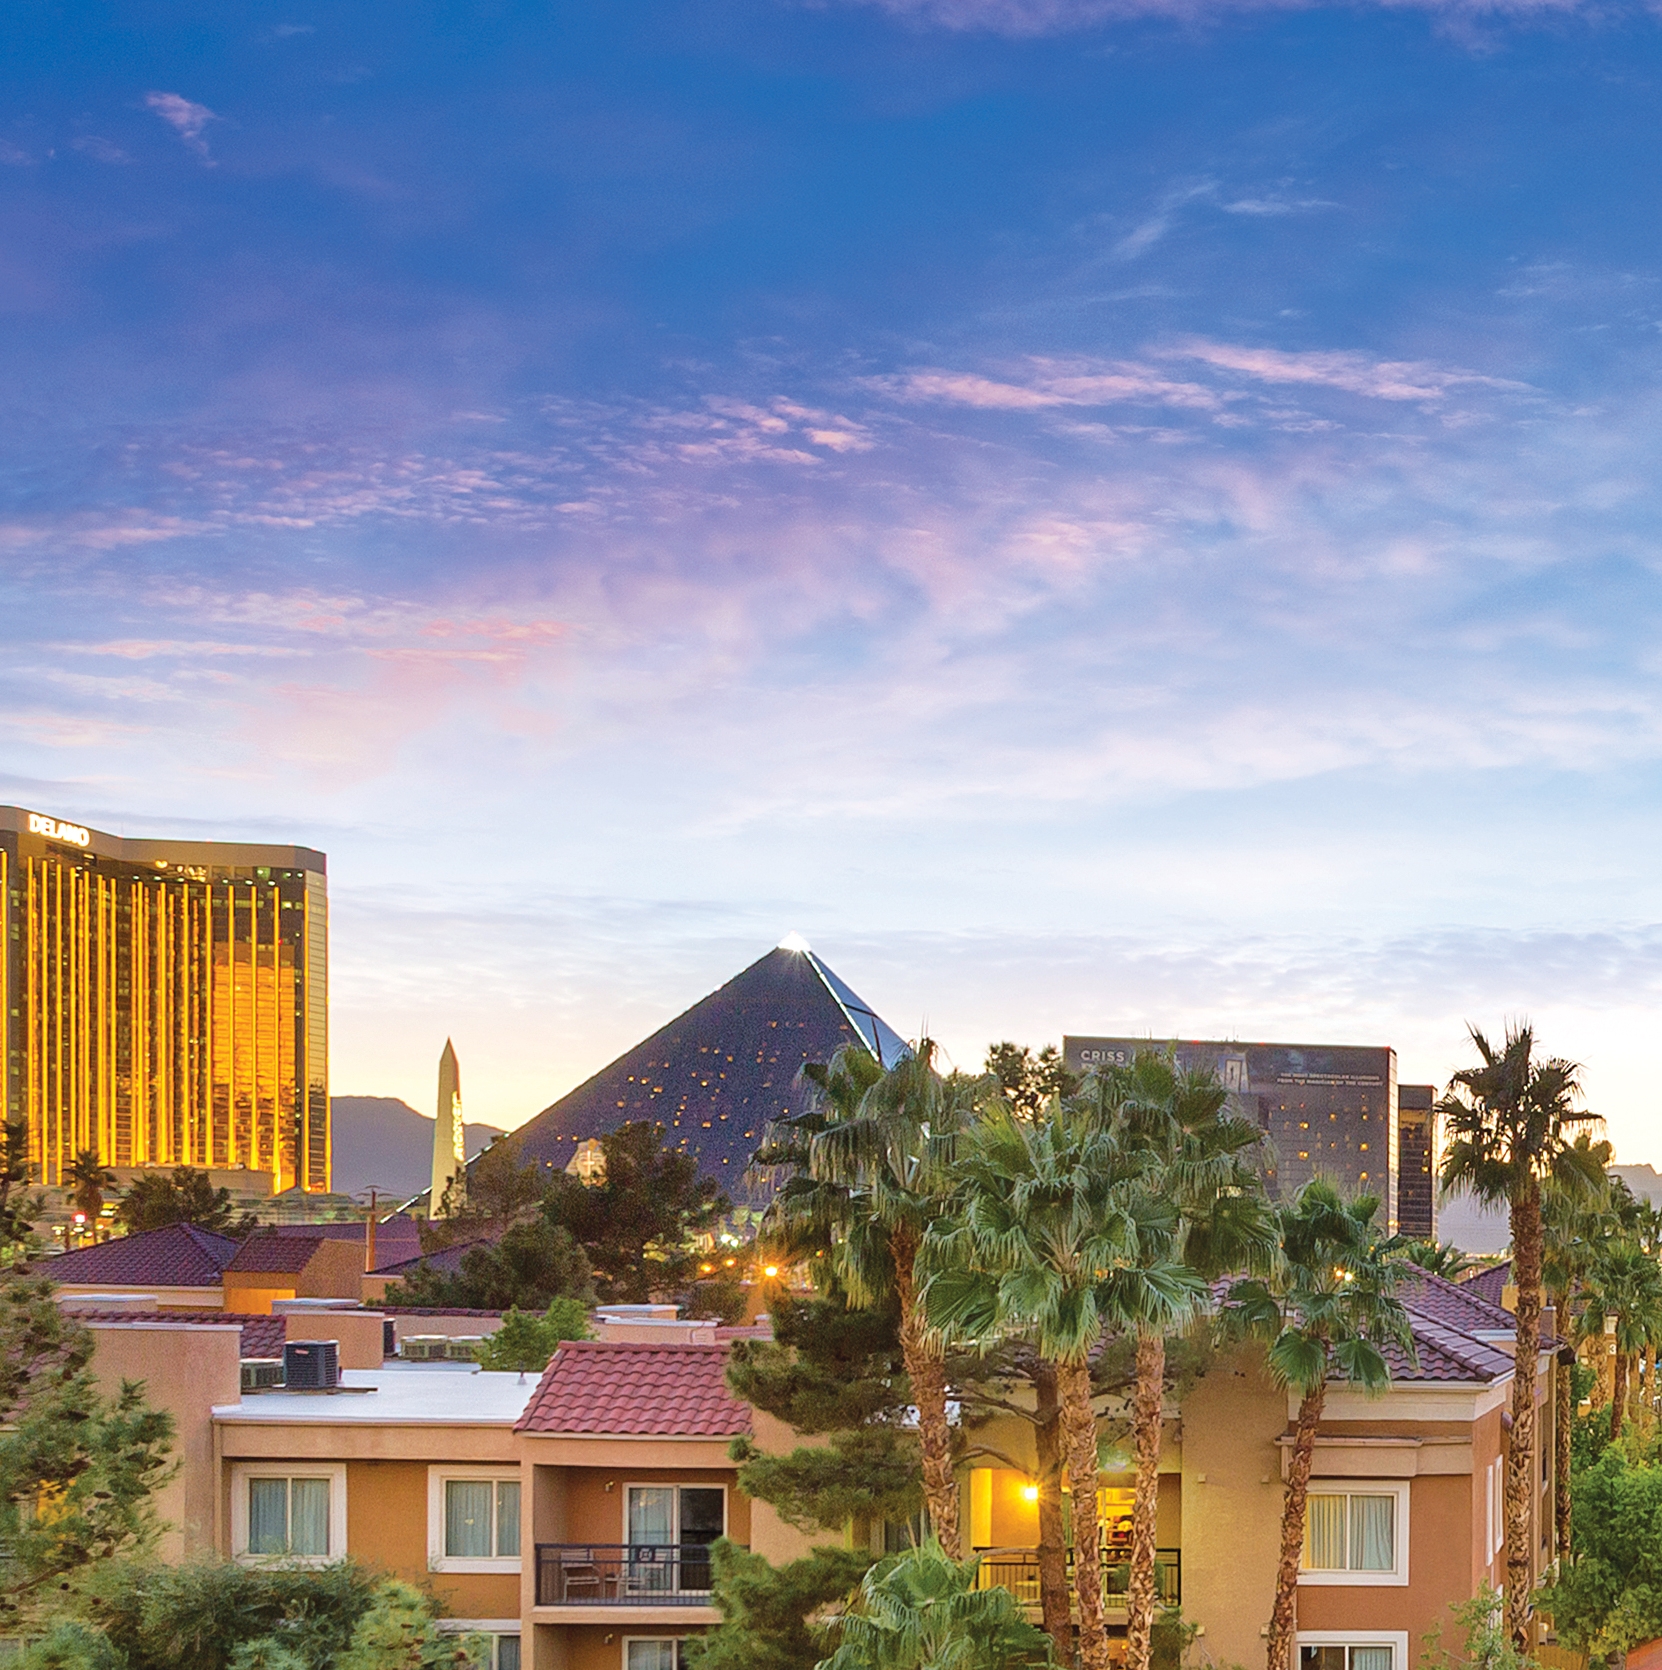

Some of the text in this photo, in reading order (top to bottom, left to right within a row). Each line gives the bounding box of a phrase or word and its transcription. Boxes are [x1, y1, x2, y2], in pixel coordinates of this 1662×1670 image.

[29, 813, 90, 847] DELANO
[1080, 1050, 1125, 1062] CRISS
[1609, 1343, 1617, 1355] 3
